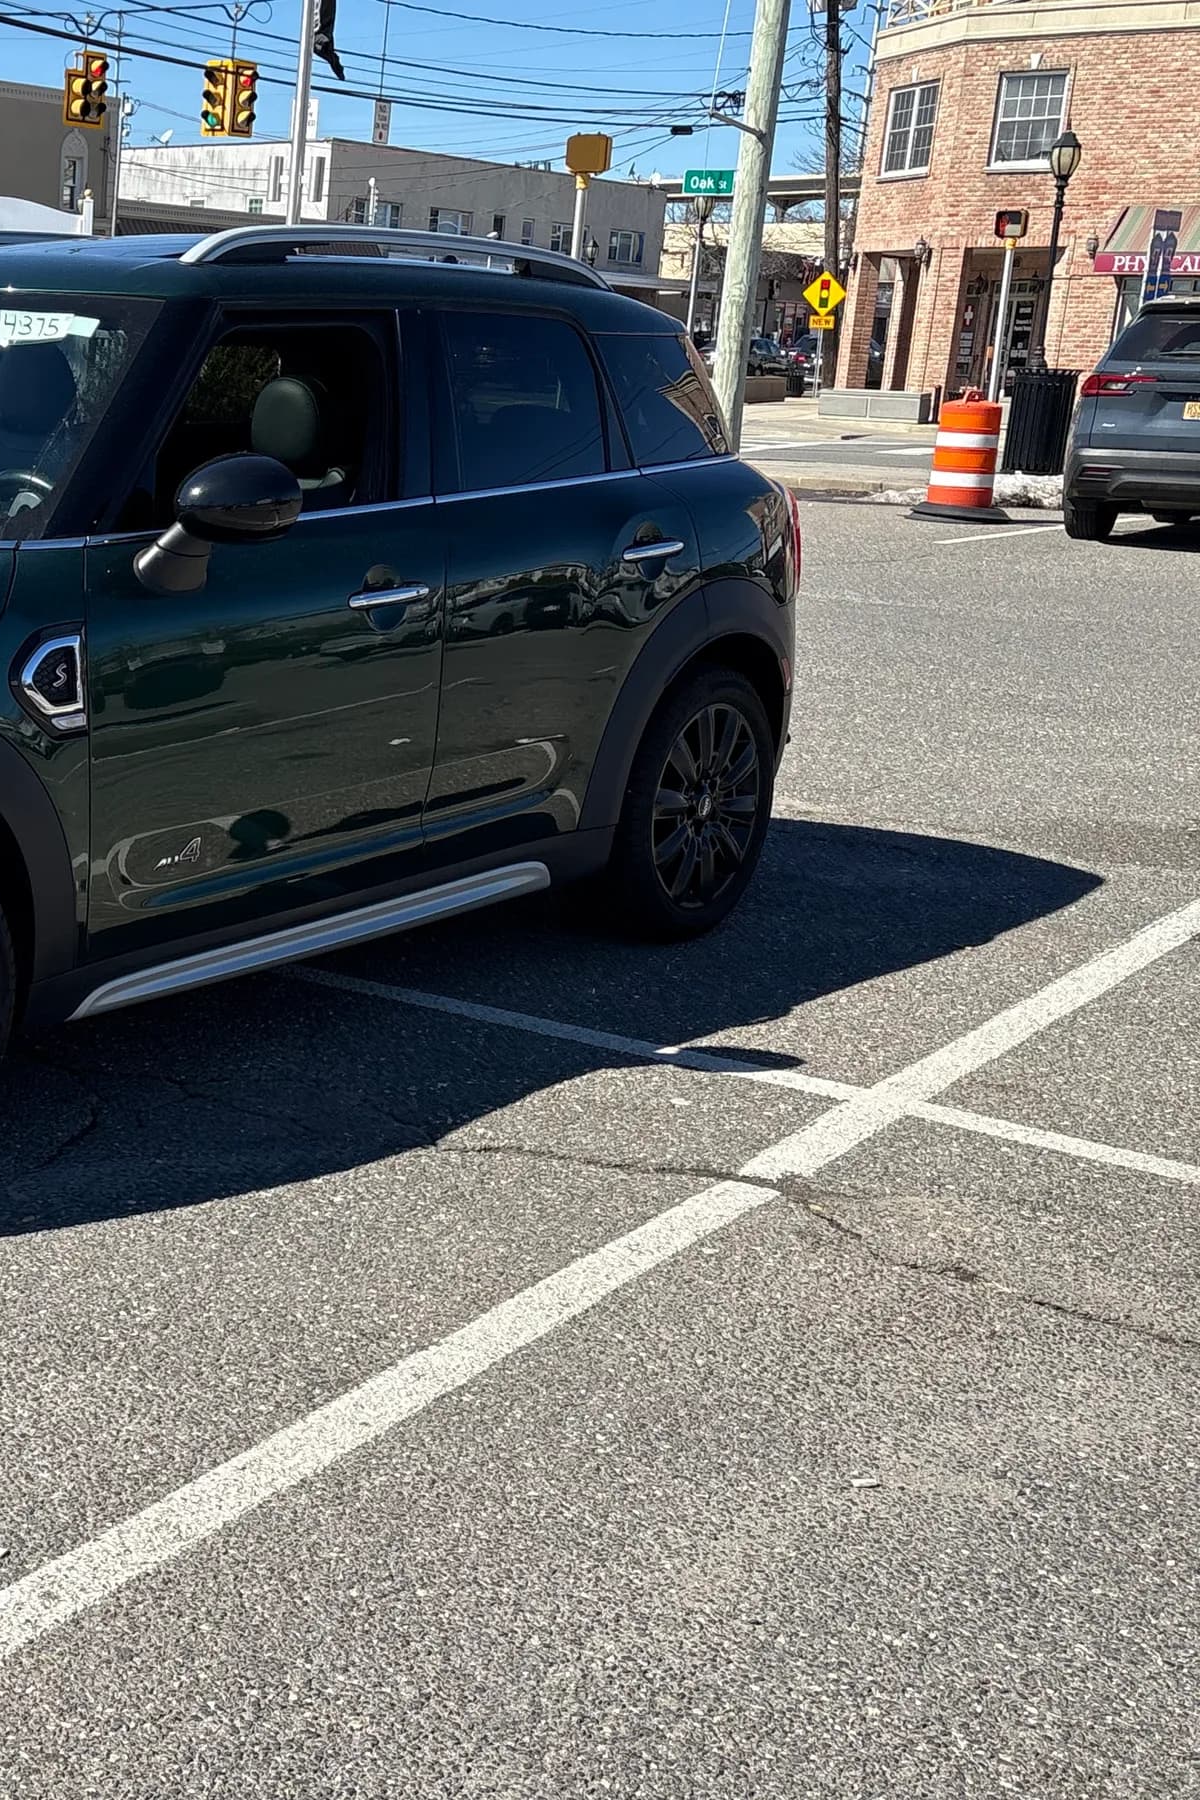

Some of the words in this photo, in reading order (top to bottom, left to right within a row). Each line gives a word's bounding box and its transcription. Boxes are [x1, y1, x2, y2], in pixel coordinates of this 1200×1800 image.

[690, 176, 715, 189] Oak
[718, 180, 727, 190] St
[811, 318, 832, 326] NEW
[52, 663, 67, 688] S
